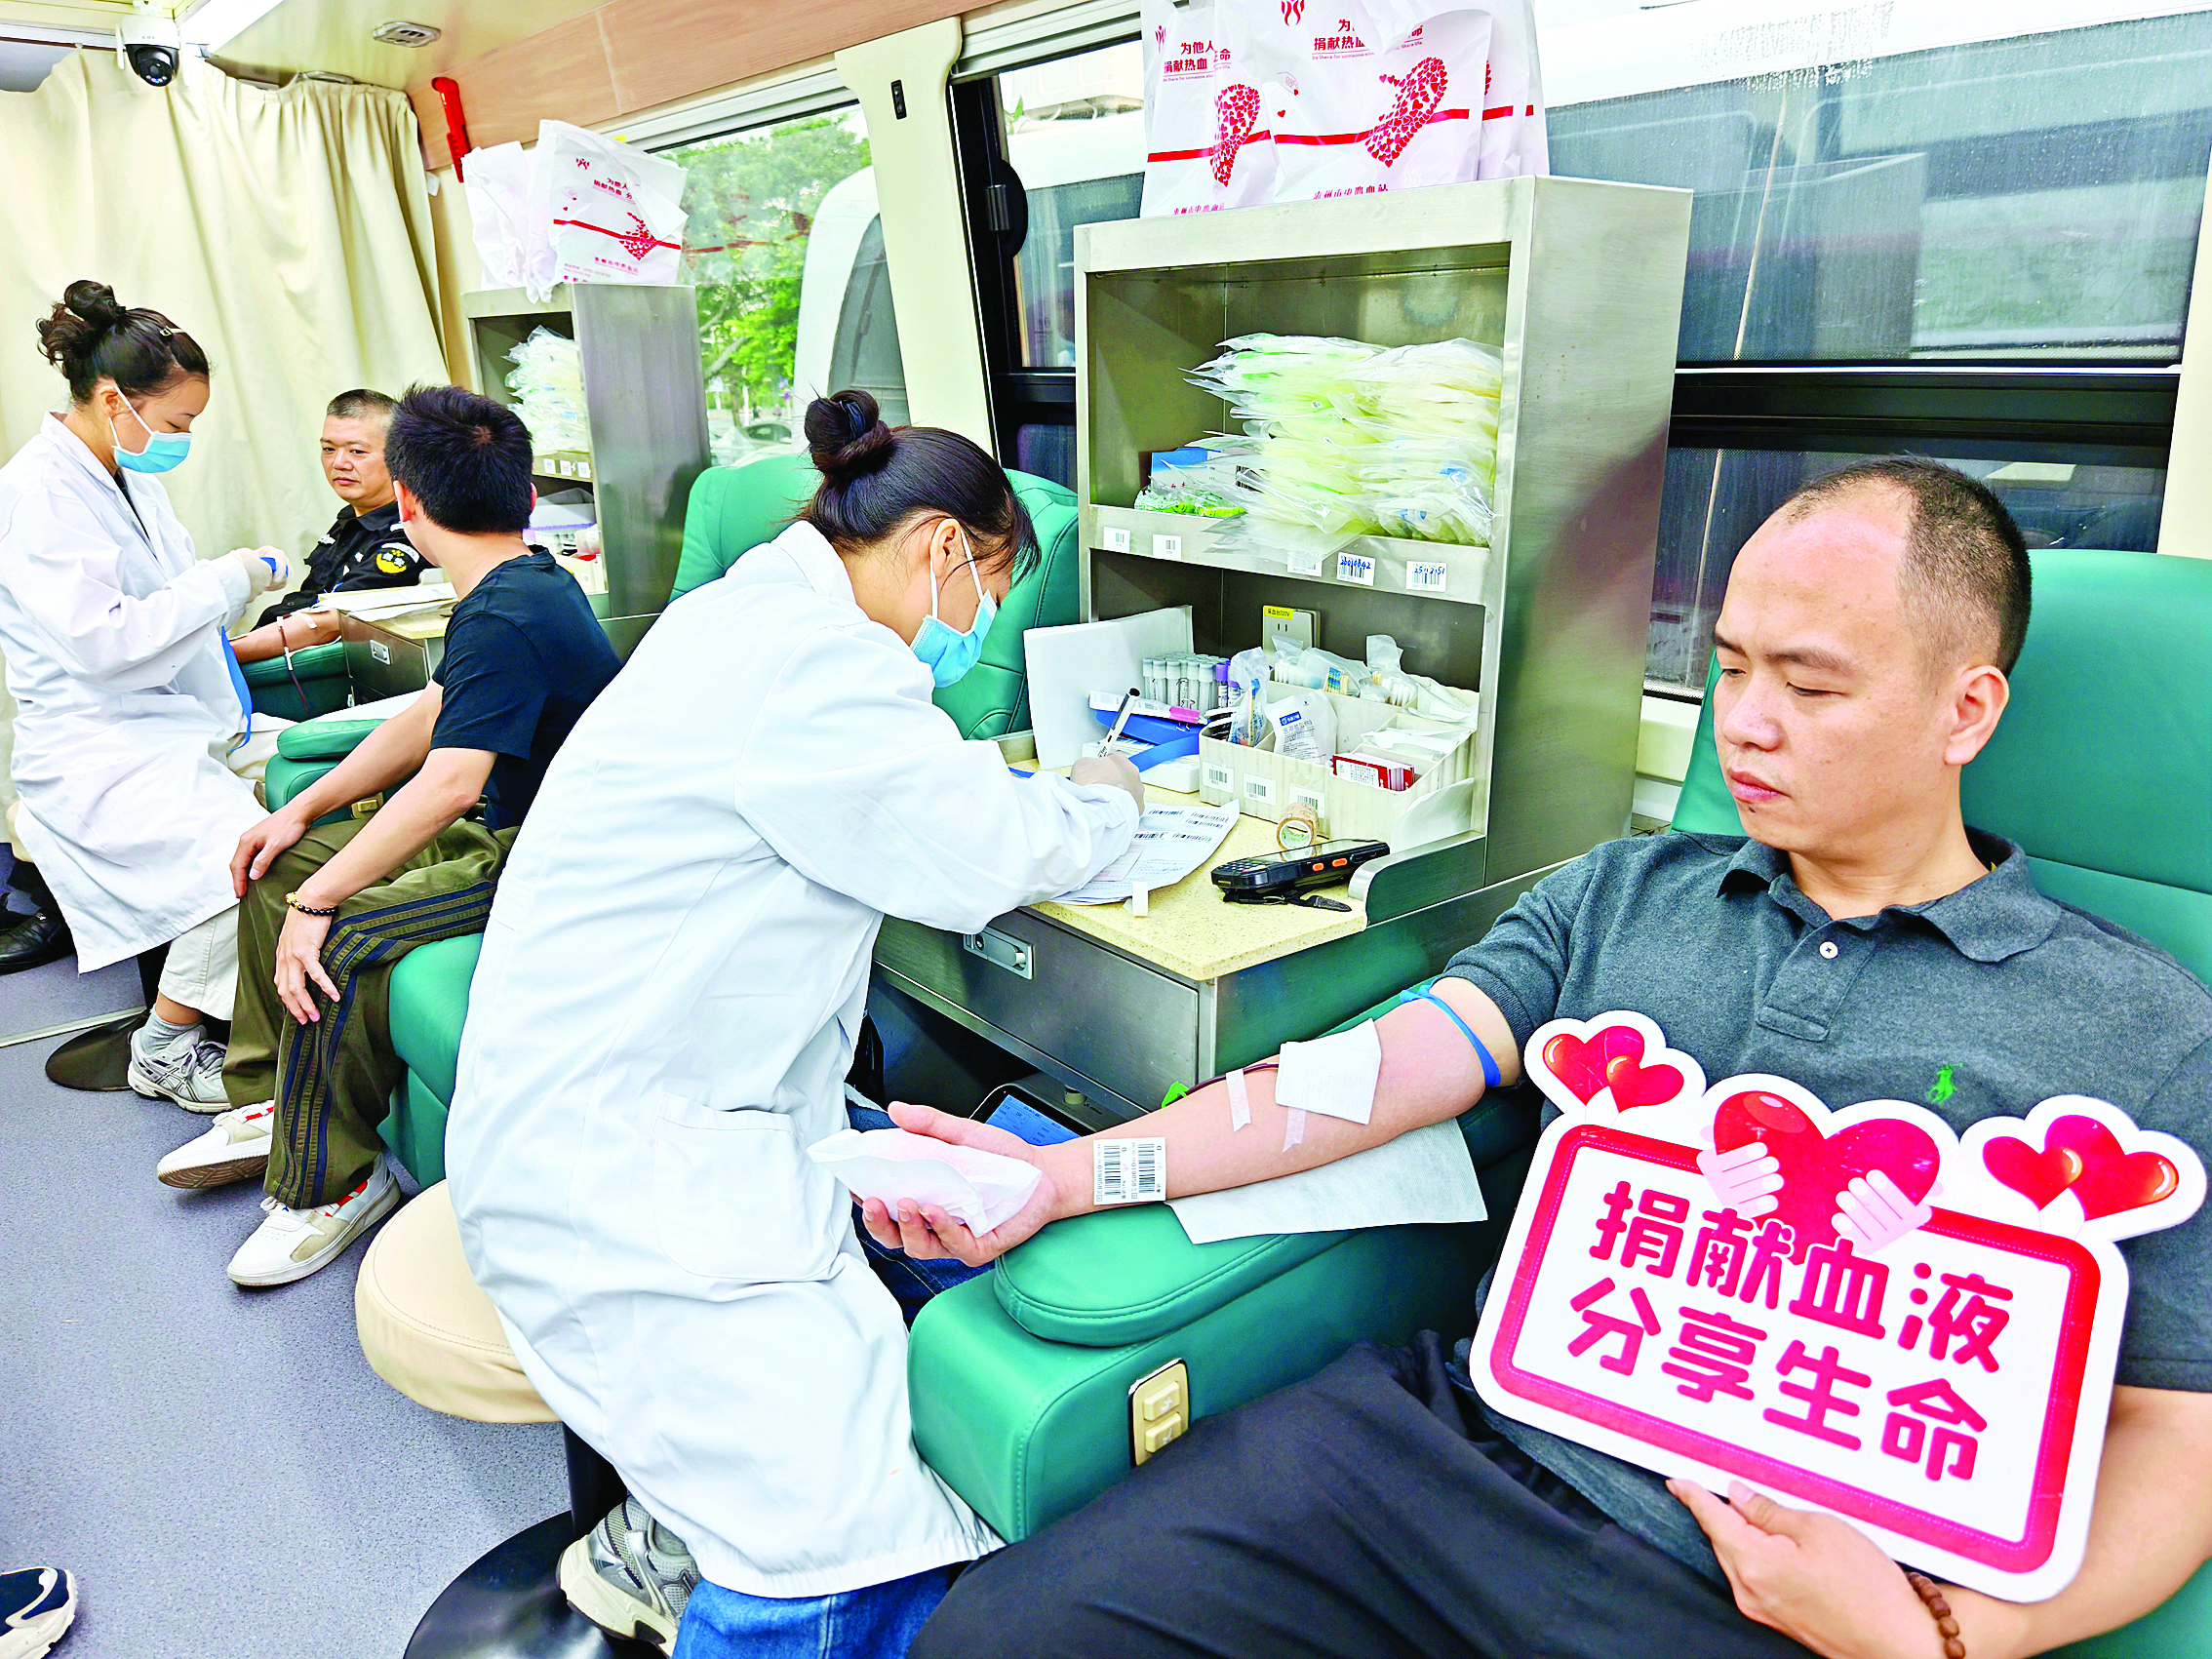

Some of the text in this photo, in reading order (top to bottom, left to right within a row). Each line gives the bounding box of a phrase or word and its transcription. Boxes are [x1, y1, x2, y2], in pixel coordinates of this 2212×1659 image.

[1590, 1181, 2013, 1373] 捐献血液
[1568, 1277, 1988, 1481] 分享生命
